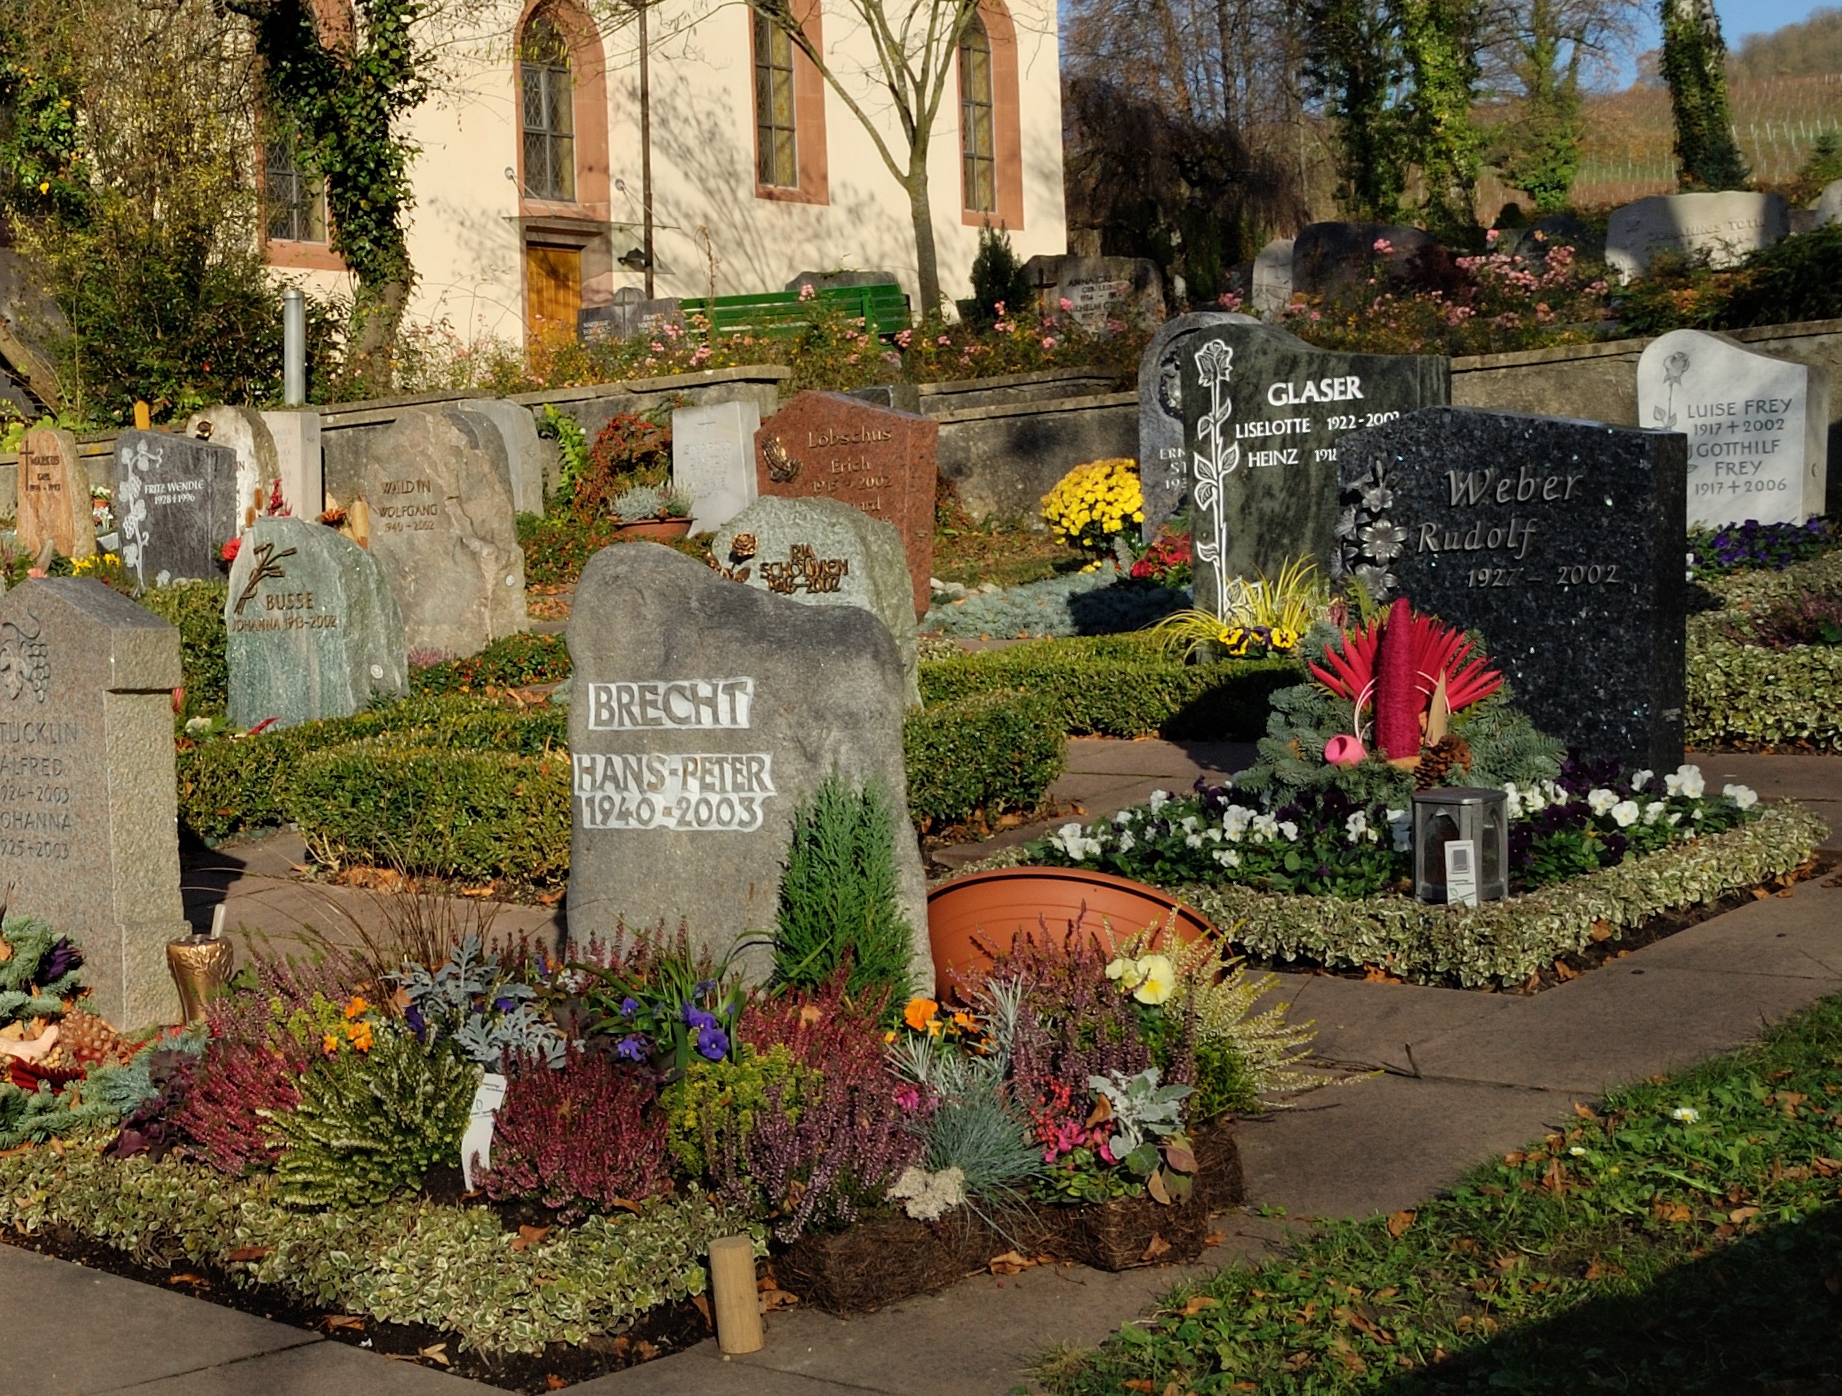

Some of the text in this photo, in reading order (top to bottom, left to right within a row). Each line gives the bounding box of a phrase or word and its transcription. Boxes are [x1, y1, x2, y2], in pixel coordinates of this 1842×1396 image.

[1268, 376, 1364, 406] GLASER
[1688, 398, 1792, 418] LUISE FREY
[1235, 418, 1311, 439] LISELOTTE
[1694, 423, 1722, 436] 1917
[1743, 418, 1784, 433] 2002
[1696, 439, 1780, 457] GOTTHILF
[831, 455, 871, 474] Erich
[1248, 448, 1299, 468] HEINZ
[1715, 461, 1762, 477] FREY
[145, 480, 204, 494] FRITZ WENDLE
[381, 479, 431, 494] WALDIN
[1445, 465, 1584, 506] Weber
[1695, 482, 1724, 496] 1917
[1745, 478, 1787, 492] 2006
[378, 504, 438, 517] WOLFGANG
[1417, 518, 1539, 560] Rudolf
[1467, 567, 1524, 588] 1927
[1557, 564, 1621, 585] 2002
[265, 592, 314, 611] BUSSE
[232, 618, 280, 632] JOHANNA
[593, 681, 750, 727] BRECHT
[0, 754, 63, 776] ALFRED
[576, 754, 770, 794] HANS-PETER
